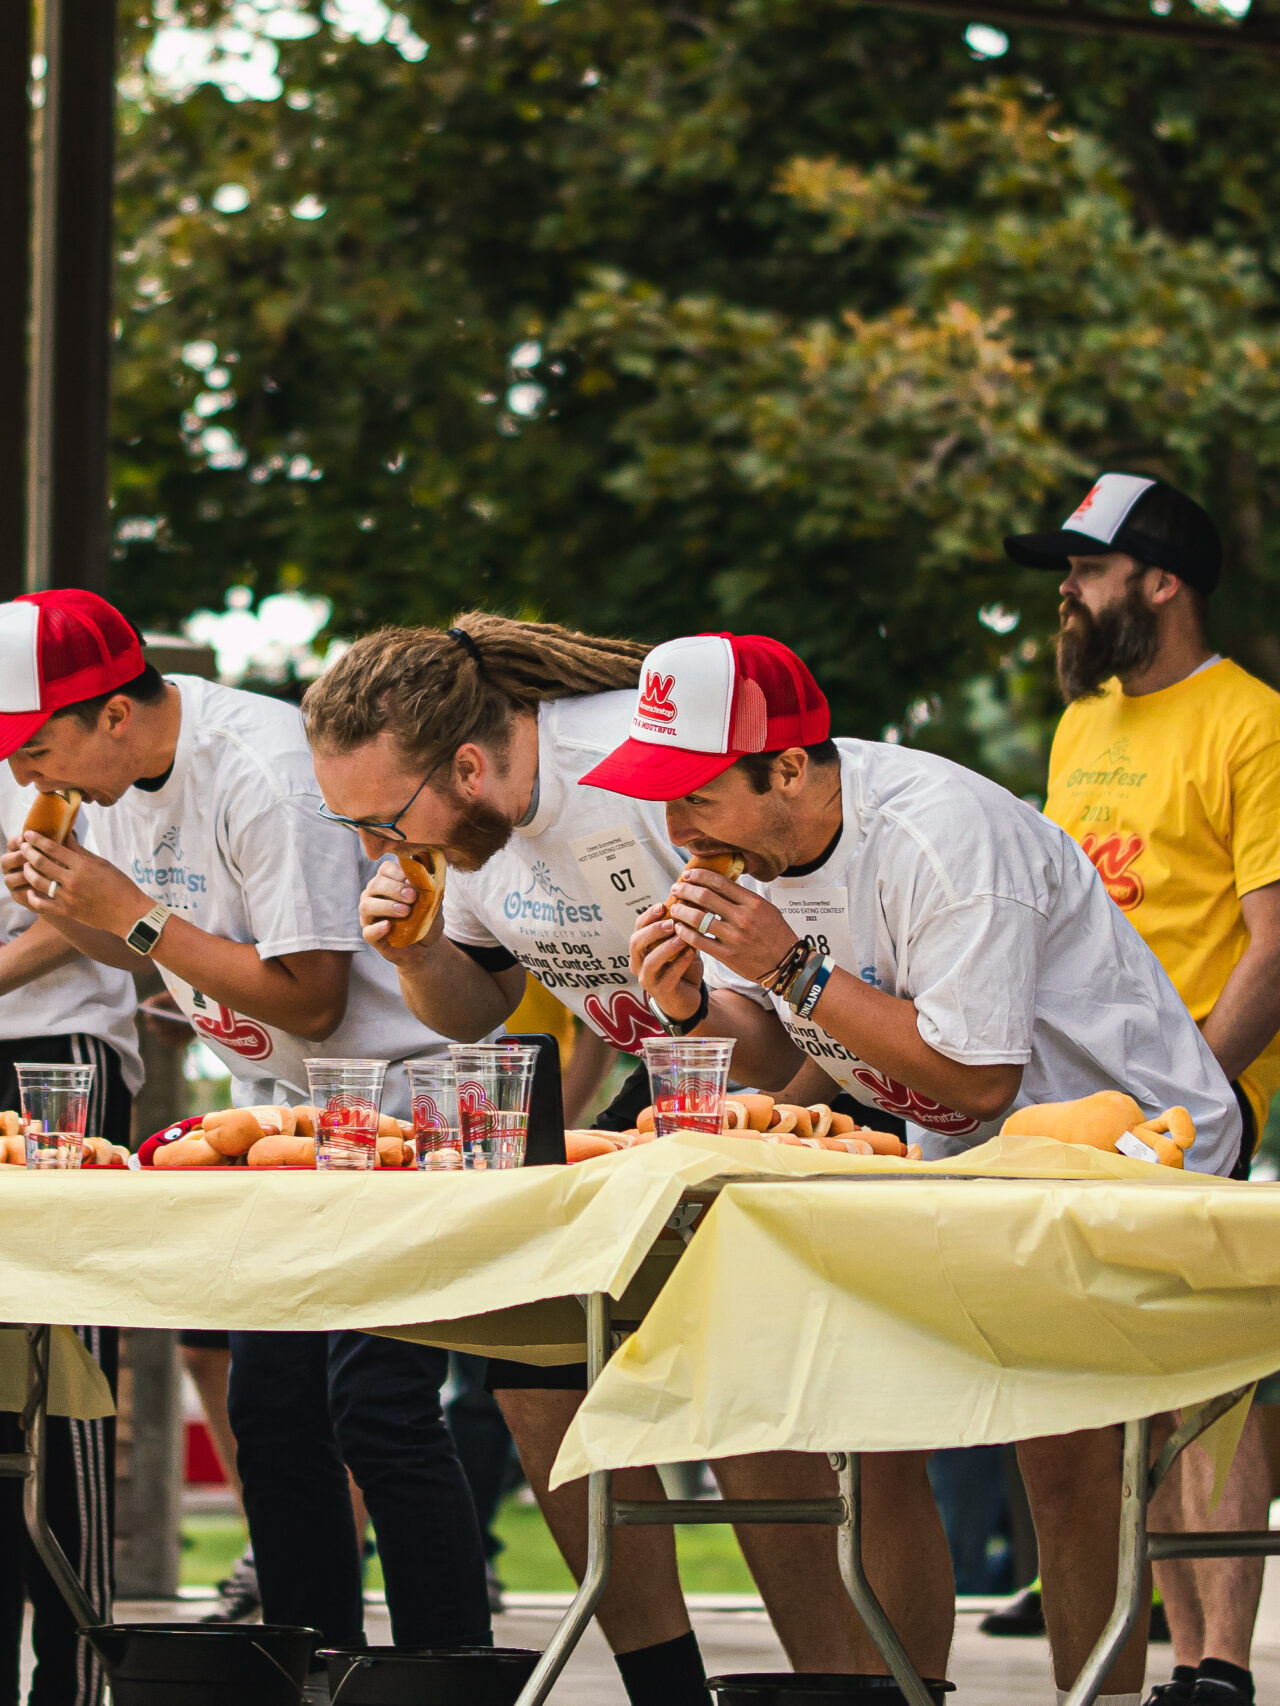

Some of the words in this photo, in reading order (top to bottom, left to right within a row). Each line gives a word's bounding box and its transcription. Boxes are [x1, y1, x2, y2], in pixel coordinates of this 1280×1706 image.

[1066, 767, 1148, 788] Oremfest
[609, 867, 636, 893] 07
[503, 891, 604, 927] Oremfest
[803, 899, 831, 907] Summerfest
[552, 930, 576, 938] CITY
[579, 930, 601, 938] USA
[534, 940, 561, 955] Hot
[561, 941, 594, 959] Dog
[552, 957, 606, 972] Contest
[525, 967, 629, 989] PONSORED
